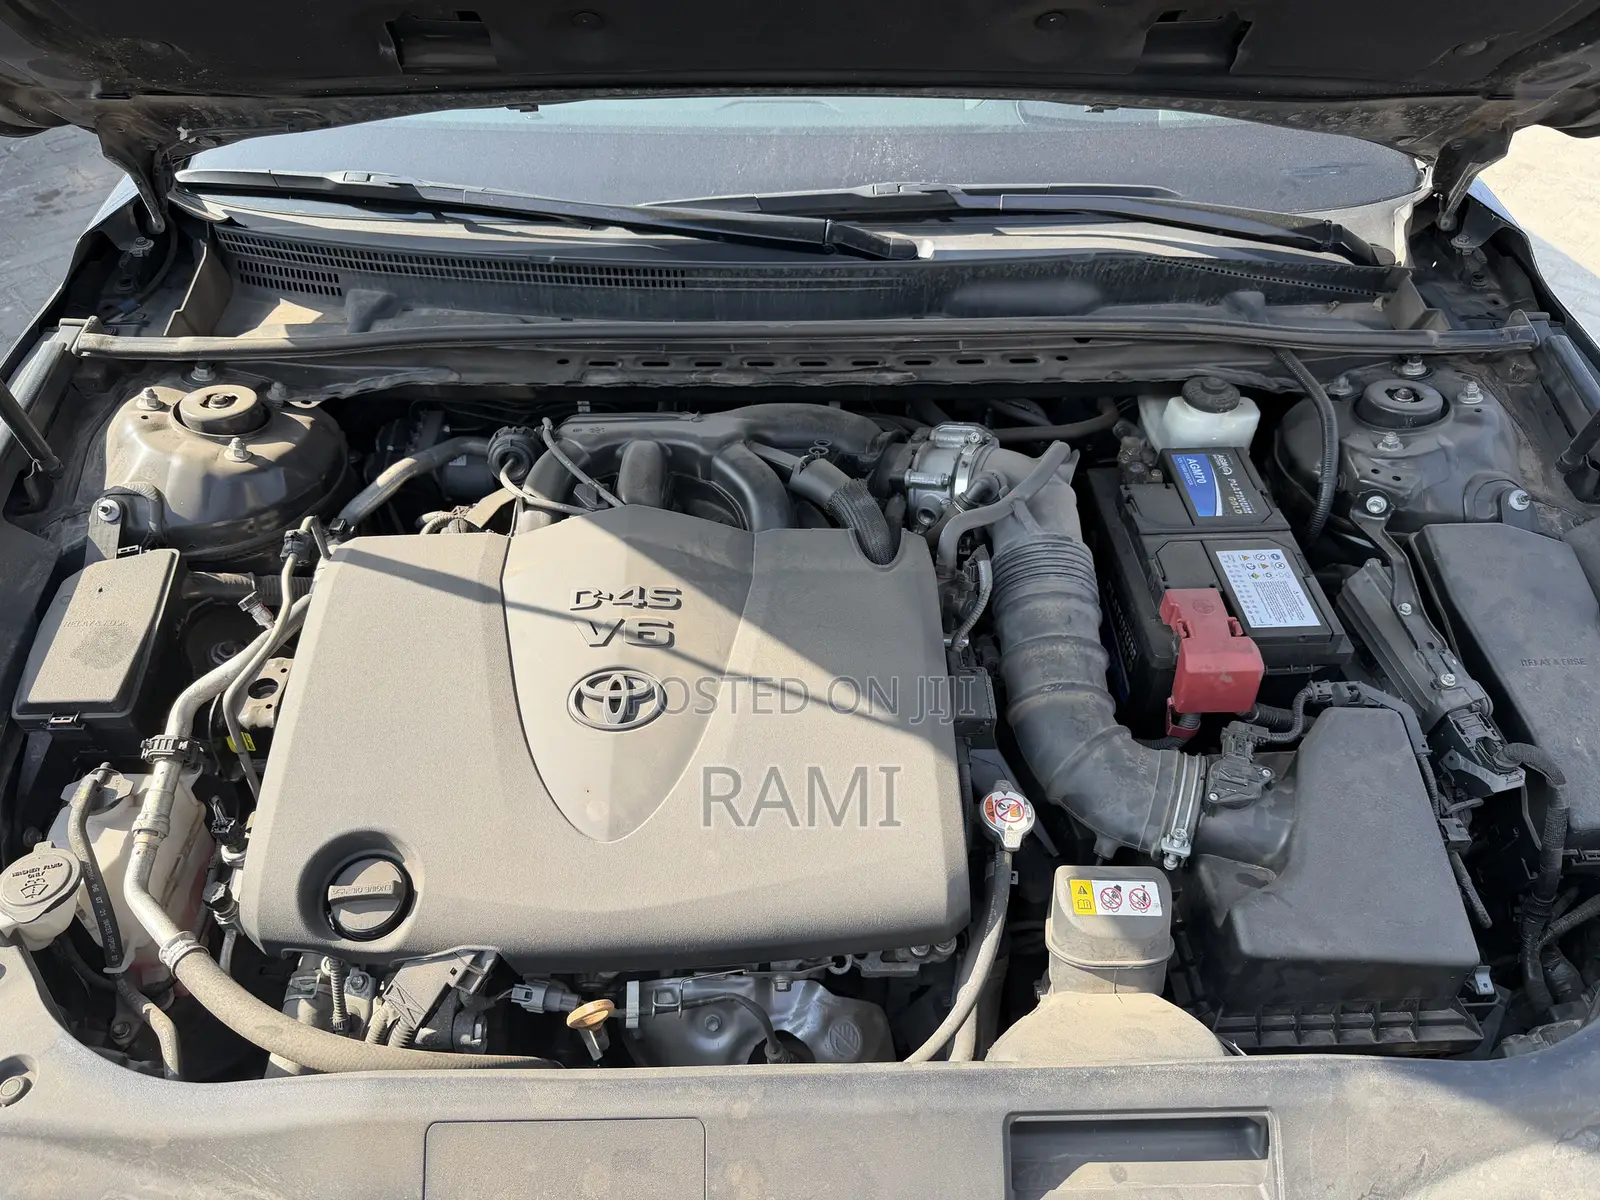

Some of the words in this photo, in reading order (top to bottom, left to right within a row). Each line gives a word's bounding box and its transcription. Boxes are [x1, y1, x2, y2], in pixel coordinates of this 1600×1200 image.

[1187, 458, 1207, 484] AGM70
[1228, 478, 1253, 514] PLATINUM
[1228, 496, 1243, 515] GOLD
[573, 617, 675, 648] V6
